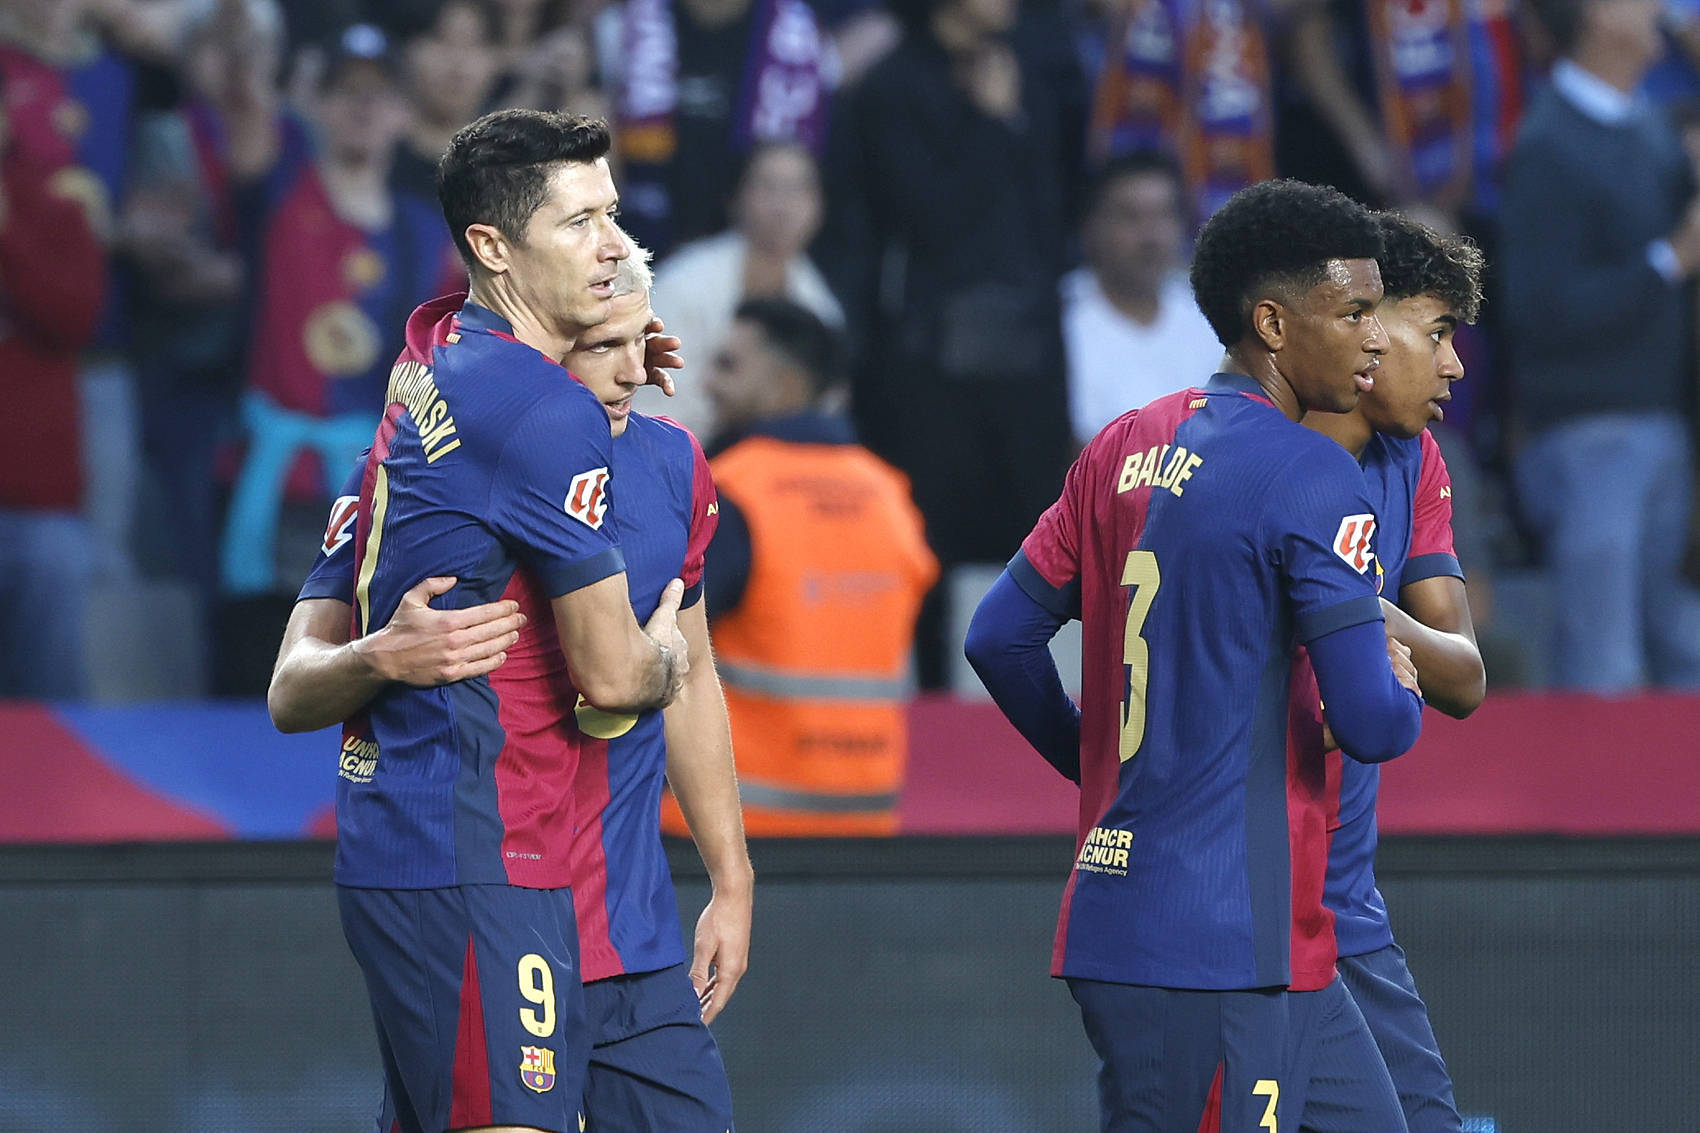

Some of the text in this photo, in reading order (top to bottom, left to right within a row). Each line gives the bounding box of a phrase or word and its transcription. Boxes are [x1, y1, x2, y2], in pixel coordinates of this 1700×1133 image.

[1117, 444, 1203, 498] BALDE
[1118, 550, 1161, 764] 3
[1086, 827, 1134, 849] NHCR
[517, 953, 557, 1038] 9
